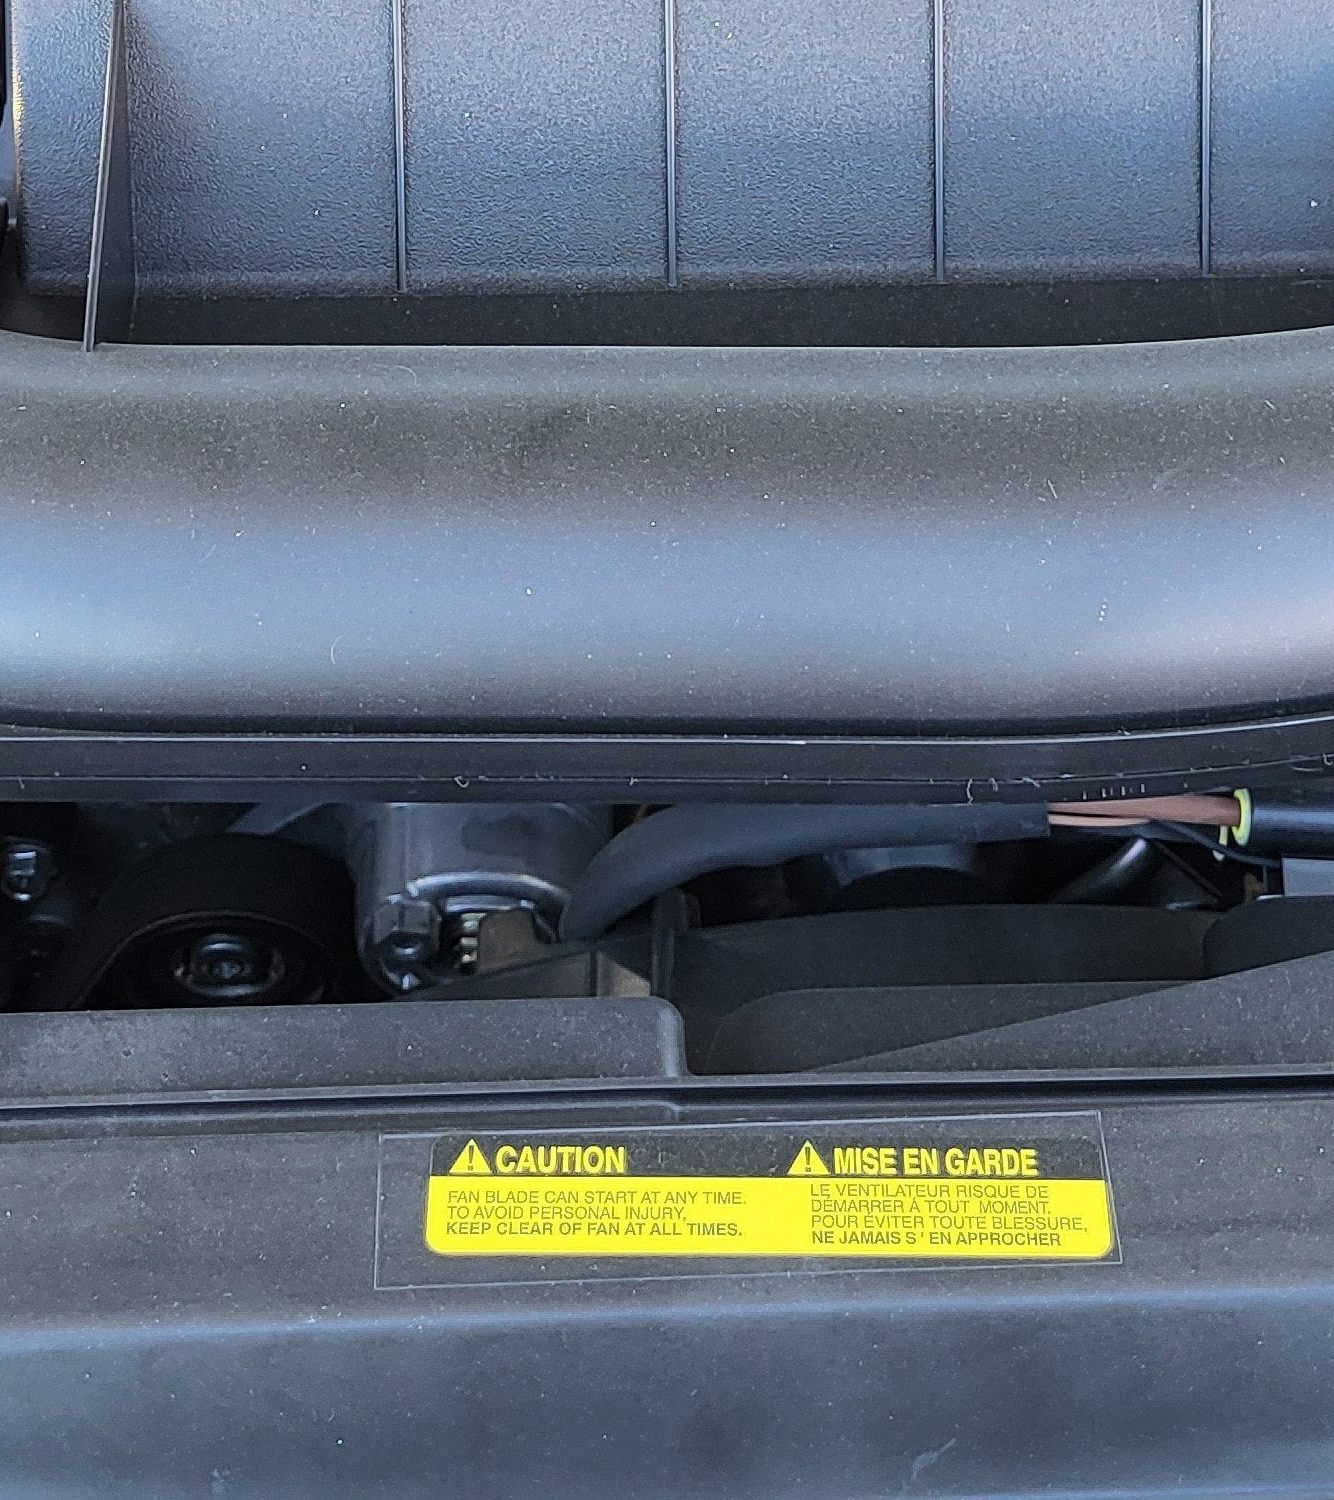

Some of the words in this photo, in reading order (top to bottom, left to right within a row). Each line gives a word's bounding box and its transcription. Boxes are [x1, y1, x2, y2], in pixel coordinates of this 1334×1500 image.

[495, 1145, 626, 1174] CAUTION
[833, 1147, 898, 1175] MISE
[903, 1148, 939, 1175] EN
[945, 1147, 1038, 1176] GARDE
[448, 1190, 480, 1204] FAN
[485, 1190, 539, 1204] BLADE
[544, 1190, 579, 1204] CAN
[584, 1190, 637, 1204] START
[641, 1191, 661, 1204] AT
[664, 1191, 698, 1204] ANY
[703, 1191, 747, 1205] TIME.
[810, 1183, 830, 1197] LE
[835, 1184, 950, 1198] VENTILATEUR
[957, 1185, 1020, 1199] RISQUE
[1026, 1185, 1049, 1199] DE
[447, 1205, 470, 1220] TO
[473, 1206, 524, 1220] AVOID
[529, 1206, 620, 1220] PERSONAL
[625, 1206, 687, 1222] INJURY,
[924, 1200, 970, 1214] TOUT
[979, 1200, 1051, 1215] MOMENT.
[446, 1221, 491, 1235] KEEP
[496, 1222, 553, 1235] CLEAR
[559, 1222, 582, 1235] OF
[587, 1222, 620, 1235] FAN
[624, 1222, 645, 1236] AT
[649, 1222, 682, 1236] ALL
[687, 1222, 743, 1237] TIMES.
[811, 1215, 858, 1229] POUR
[864, 1211, 925, 1229] ÉVITER
[930, 1215, 987, 1230] TOUTE
[992, 1216, 1088, 1232] BLESSURE,
[812, 1230, 835, 1245] NE
[839, 1231, 901, 1245] JAMAIS
[956, 1232, 1061, 1246] APPROCHER
